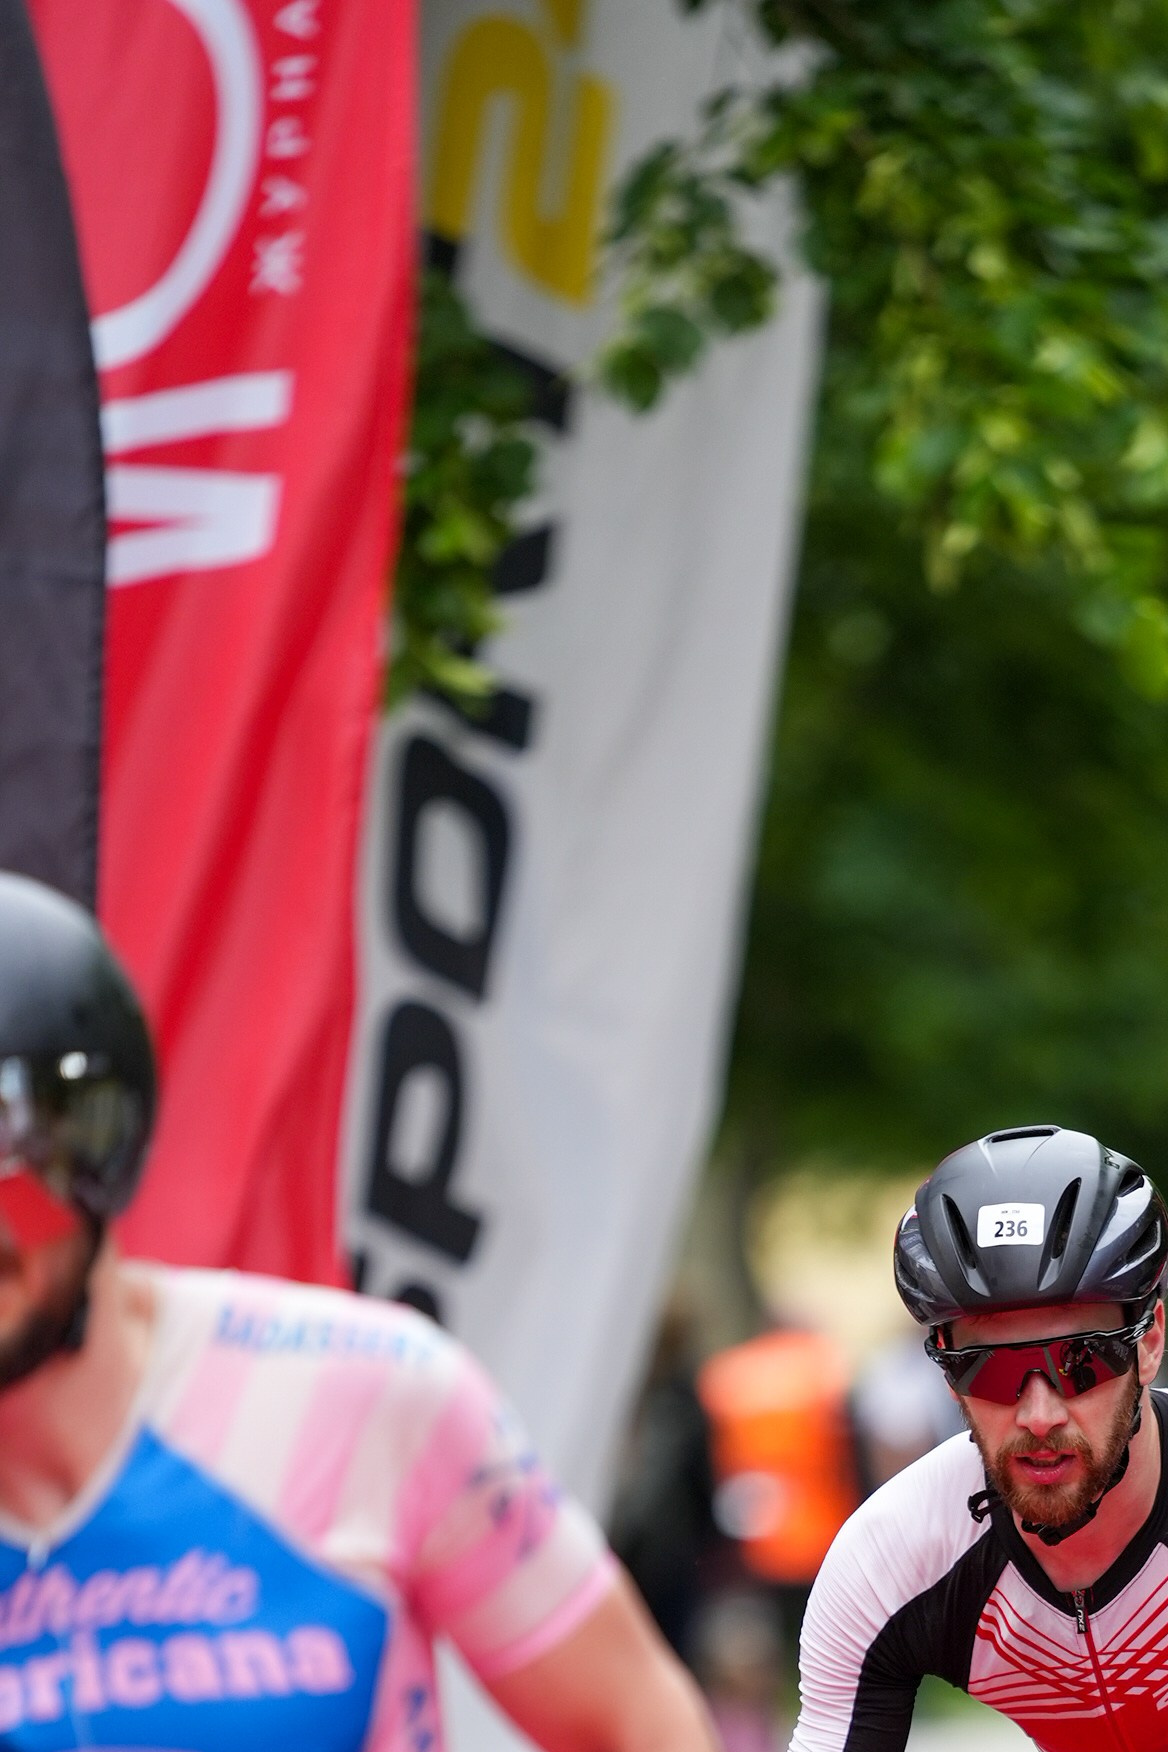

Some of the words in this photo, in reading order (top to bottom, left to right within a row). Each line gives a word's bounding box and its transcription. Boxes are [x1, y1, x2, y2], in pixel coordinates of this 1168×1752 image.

[993, 1220, 1029, 1239] 236
[0, 1548, 261, 1648] thentic
[1077, 1609, 1086, 1632] 2XU
